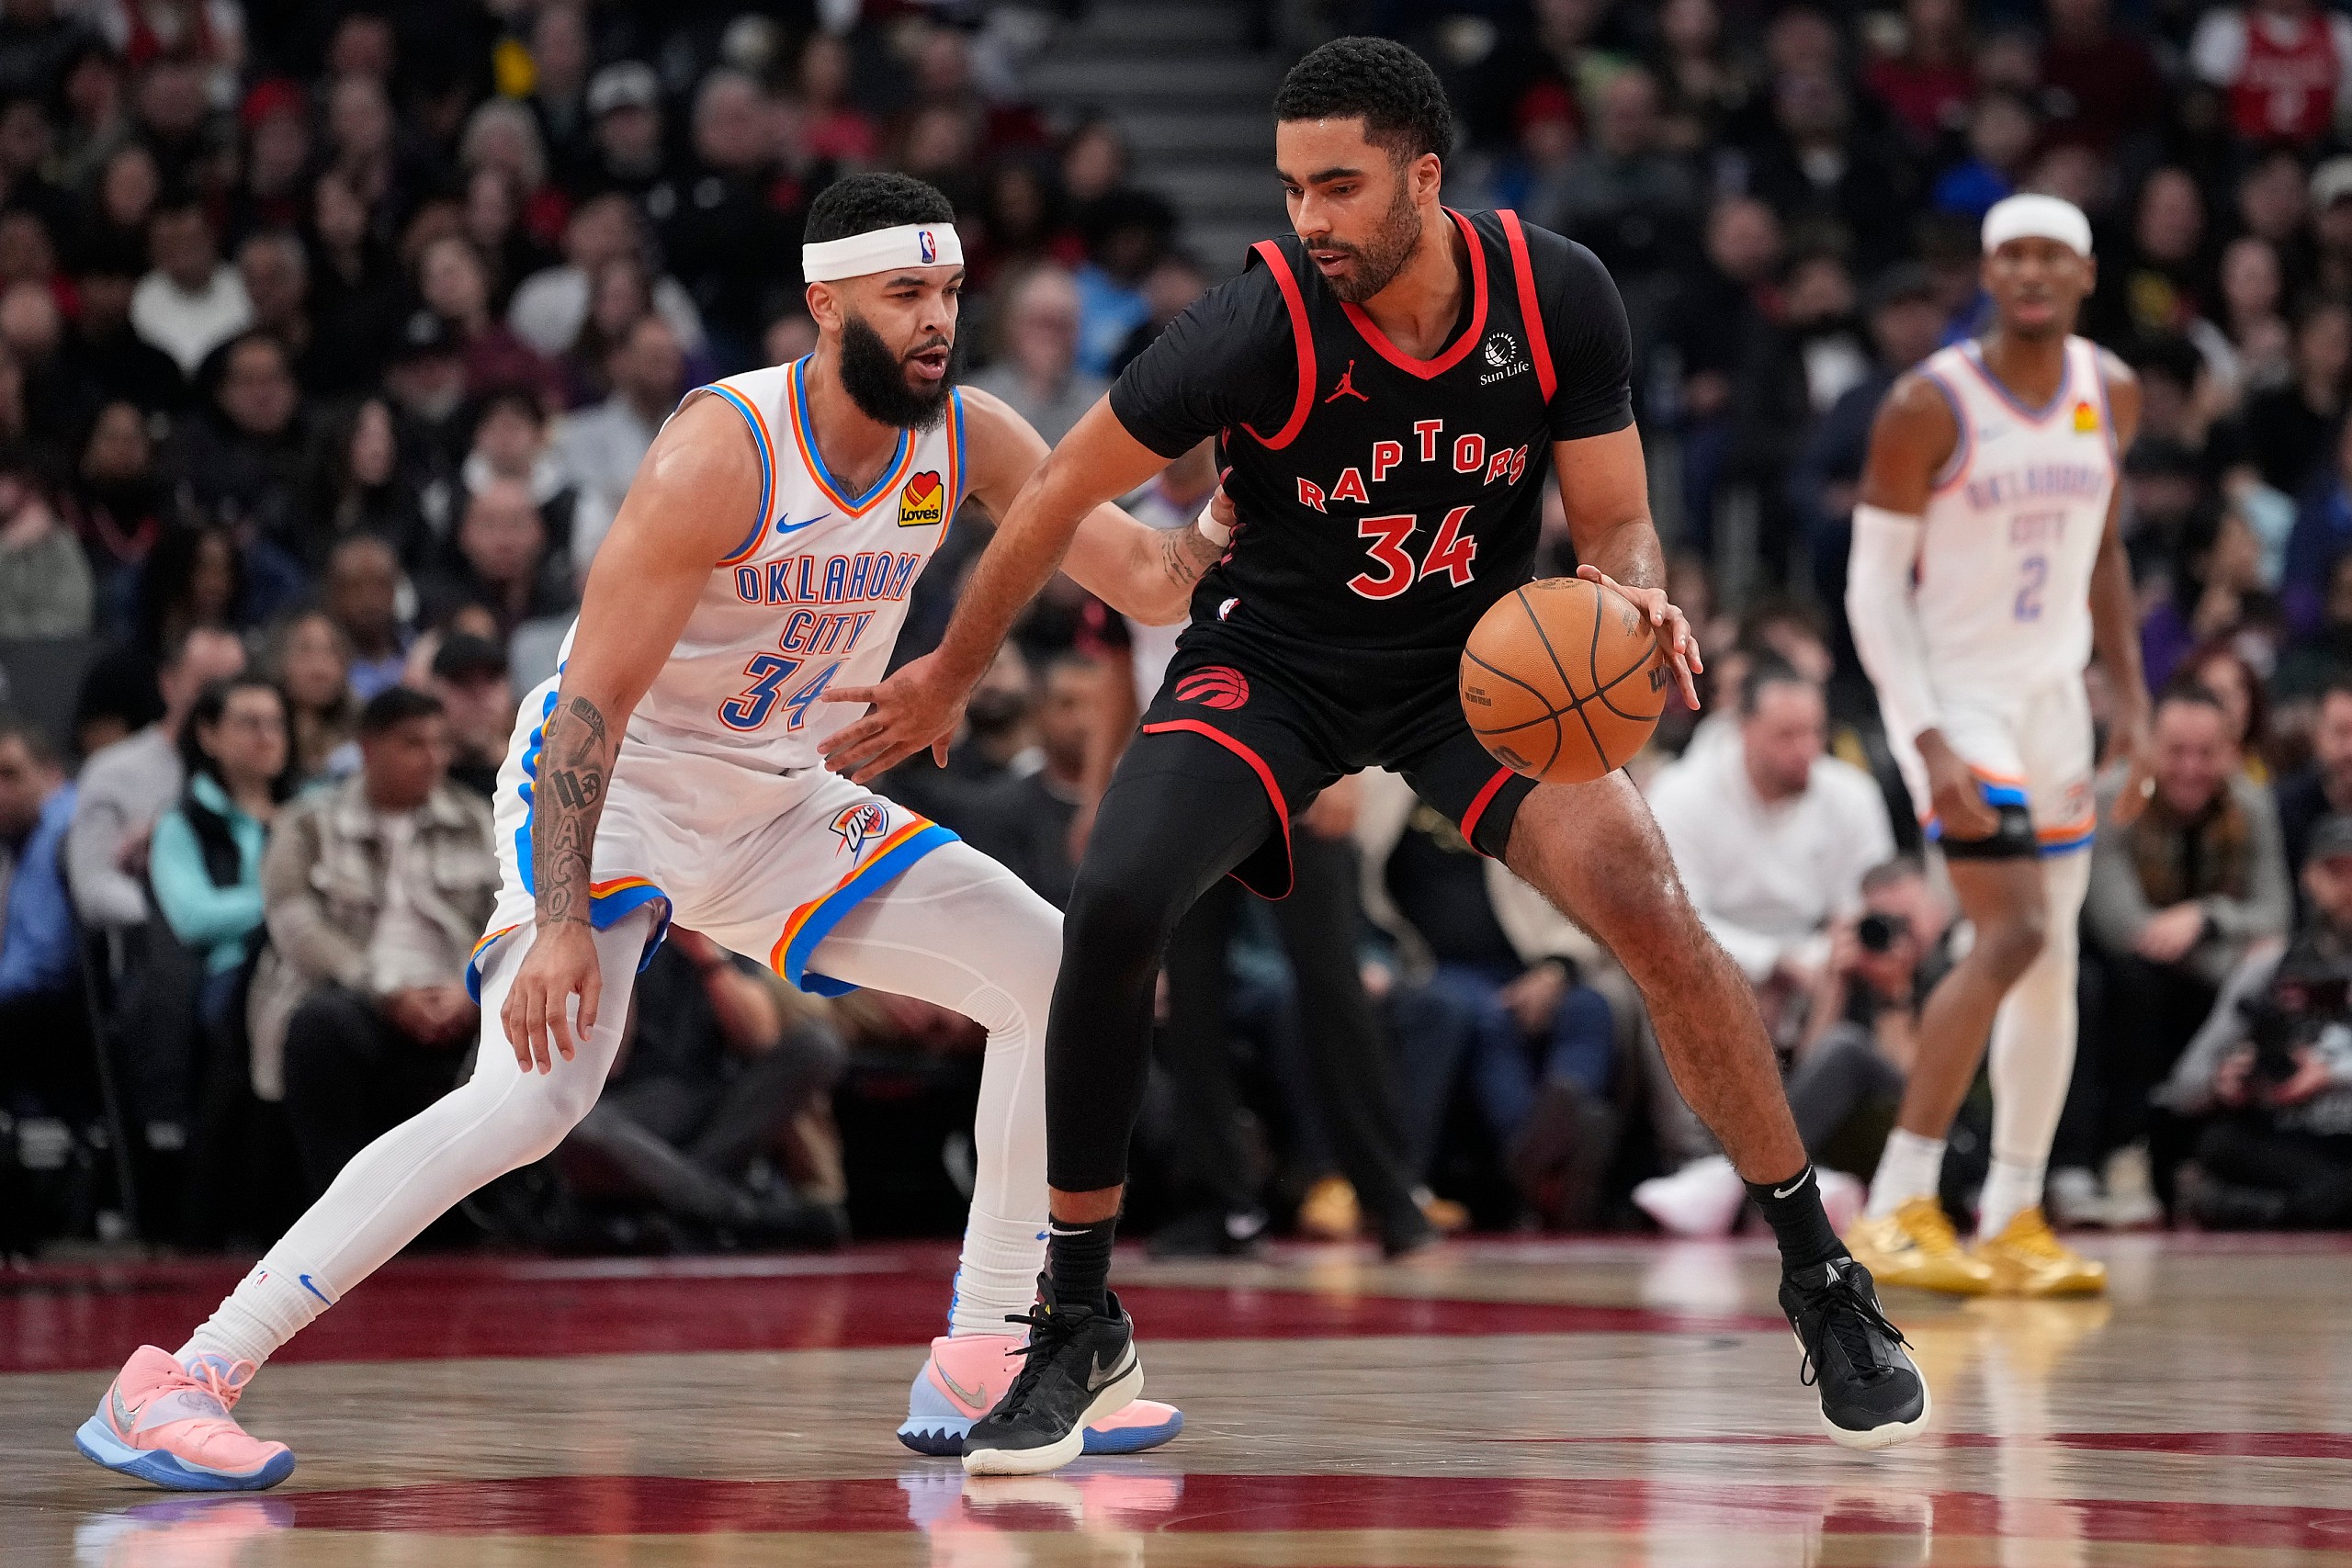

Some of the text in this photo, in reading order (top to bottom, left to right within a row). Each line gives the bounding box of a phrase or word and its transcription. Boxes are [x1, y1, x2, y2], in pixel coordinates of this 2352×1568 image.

[1480, 360, 1530, 386] Sun Life
[1296, 419, 1528, 514] RAPTORS
[734, 551, 931, 605] OKLAHOM
[1346, 505, 1477, 600] 34
[2012, 554, 2050, 623] 2
[779, 608, 876, 656] CITY
[718, 651, 851, 732] 34
[844, 805, 876, 852] OKC
